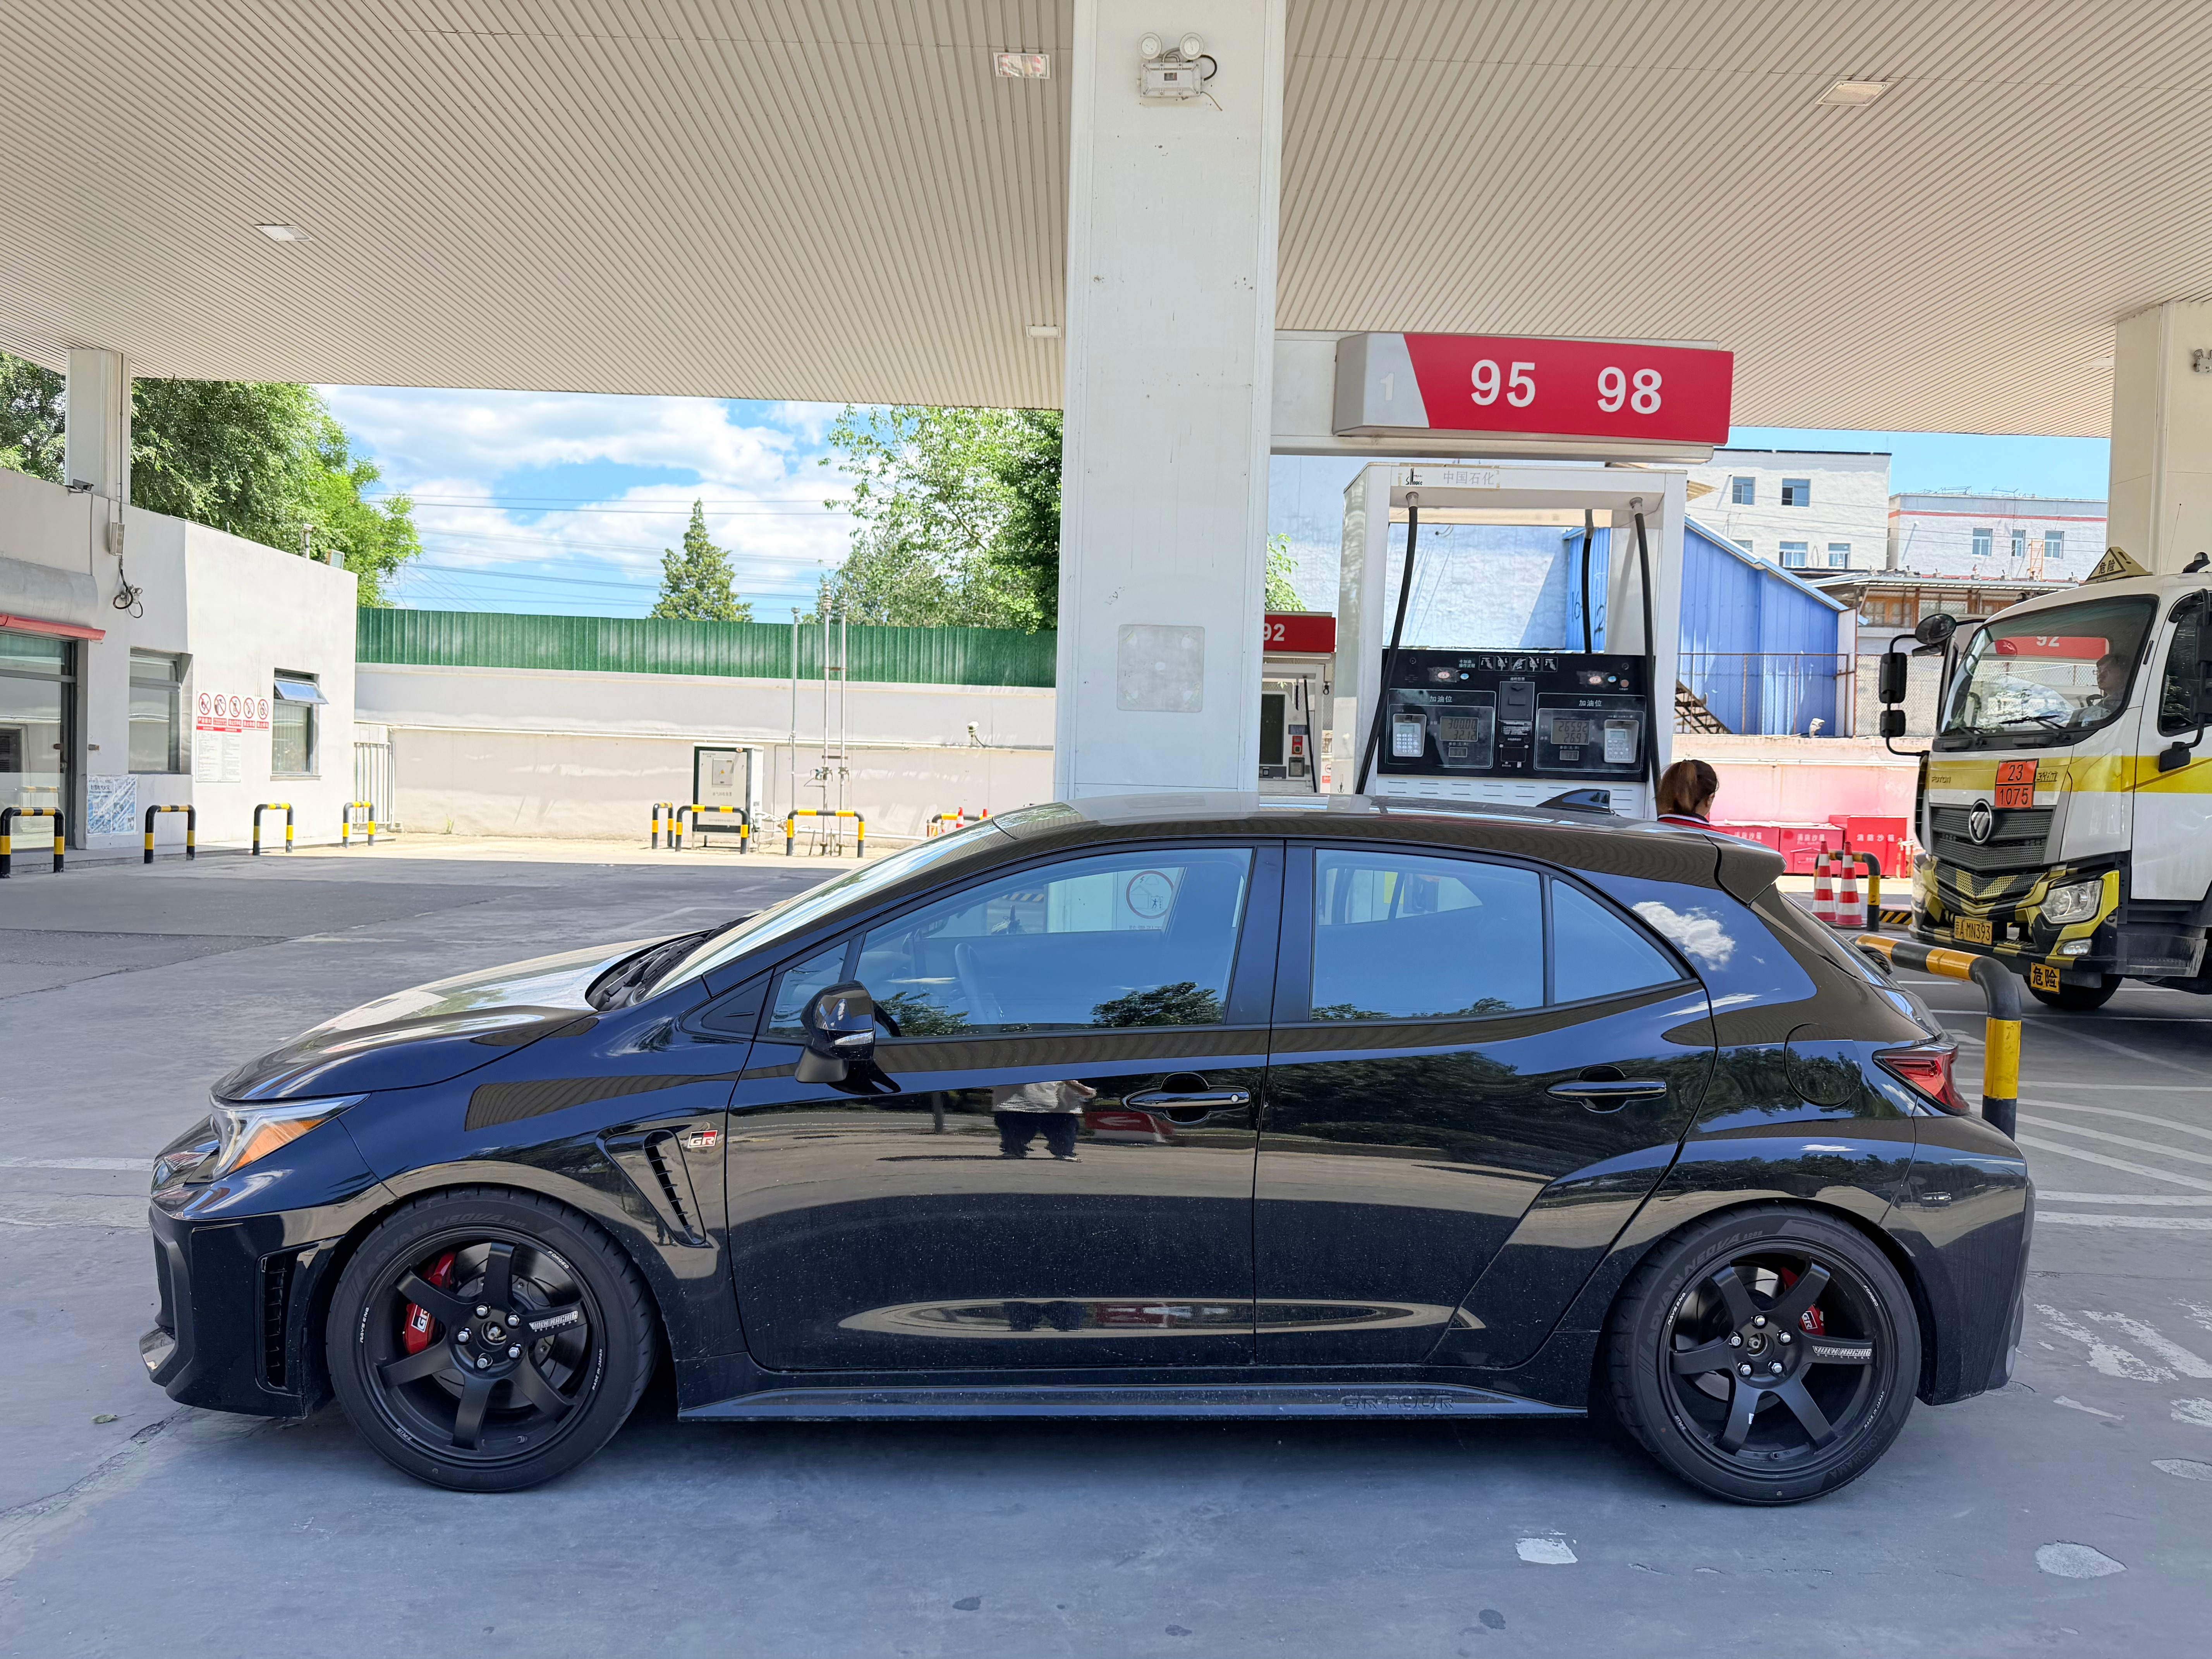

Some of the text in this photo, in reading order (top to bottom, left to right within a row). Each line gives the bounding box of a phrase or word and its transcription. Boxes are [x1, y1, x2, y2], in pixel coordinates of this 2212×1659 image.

[1380, 372, 1394, 400] 1
[1471, 359, 1662, 414] 95 98
[1444, 471, 1494, 485] 中国石化
[2099, 559, 2115, 574] 危险
[1264, 623, 1285, 641] 92
[2008, 764, 2024, 781] 23
[2000, 788, 2029, 805] 1075
[2033, 966, 2057, 988] 危险
[690, 1137, 715, 1146] GR
[431, 1213, 505, 1229] NEOVA
[547, 1250, 569, 1269] FORGED
[1646, 1273, 1684, 1346] ADVAN
[1685, 1233, 1741, 1276] NEOVA
[1863, 1285, 1879, 1307] FORGED
[550, 1310, 578, 1326] RACING
[1668, 1292, 1686, 1326] RAYS ENG
[1802, 1312, 1813, 1329] GR
[1812, 1345, 1872, 1357] VOLK RACING
[1864, 1415, 1874, 1429] MADE
[1876, 1390, 1885, 1408] JAPAN
[1828, 1434, 1883, 1479] YOKOHAMA
